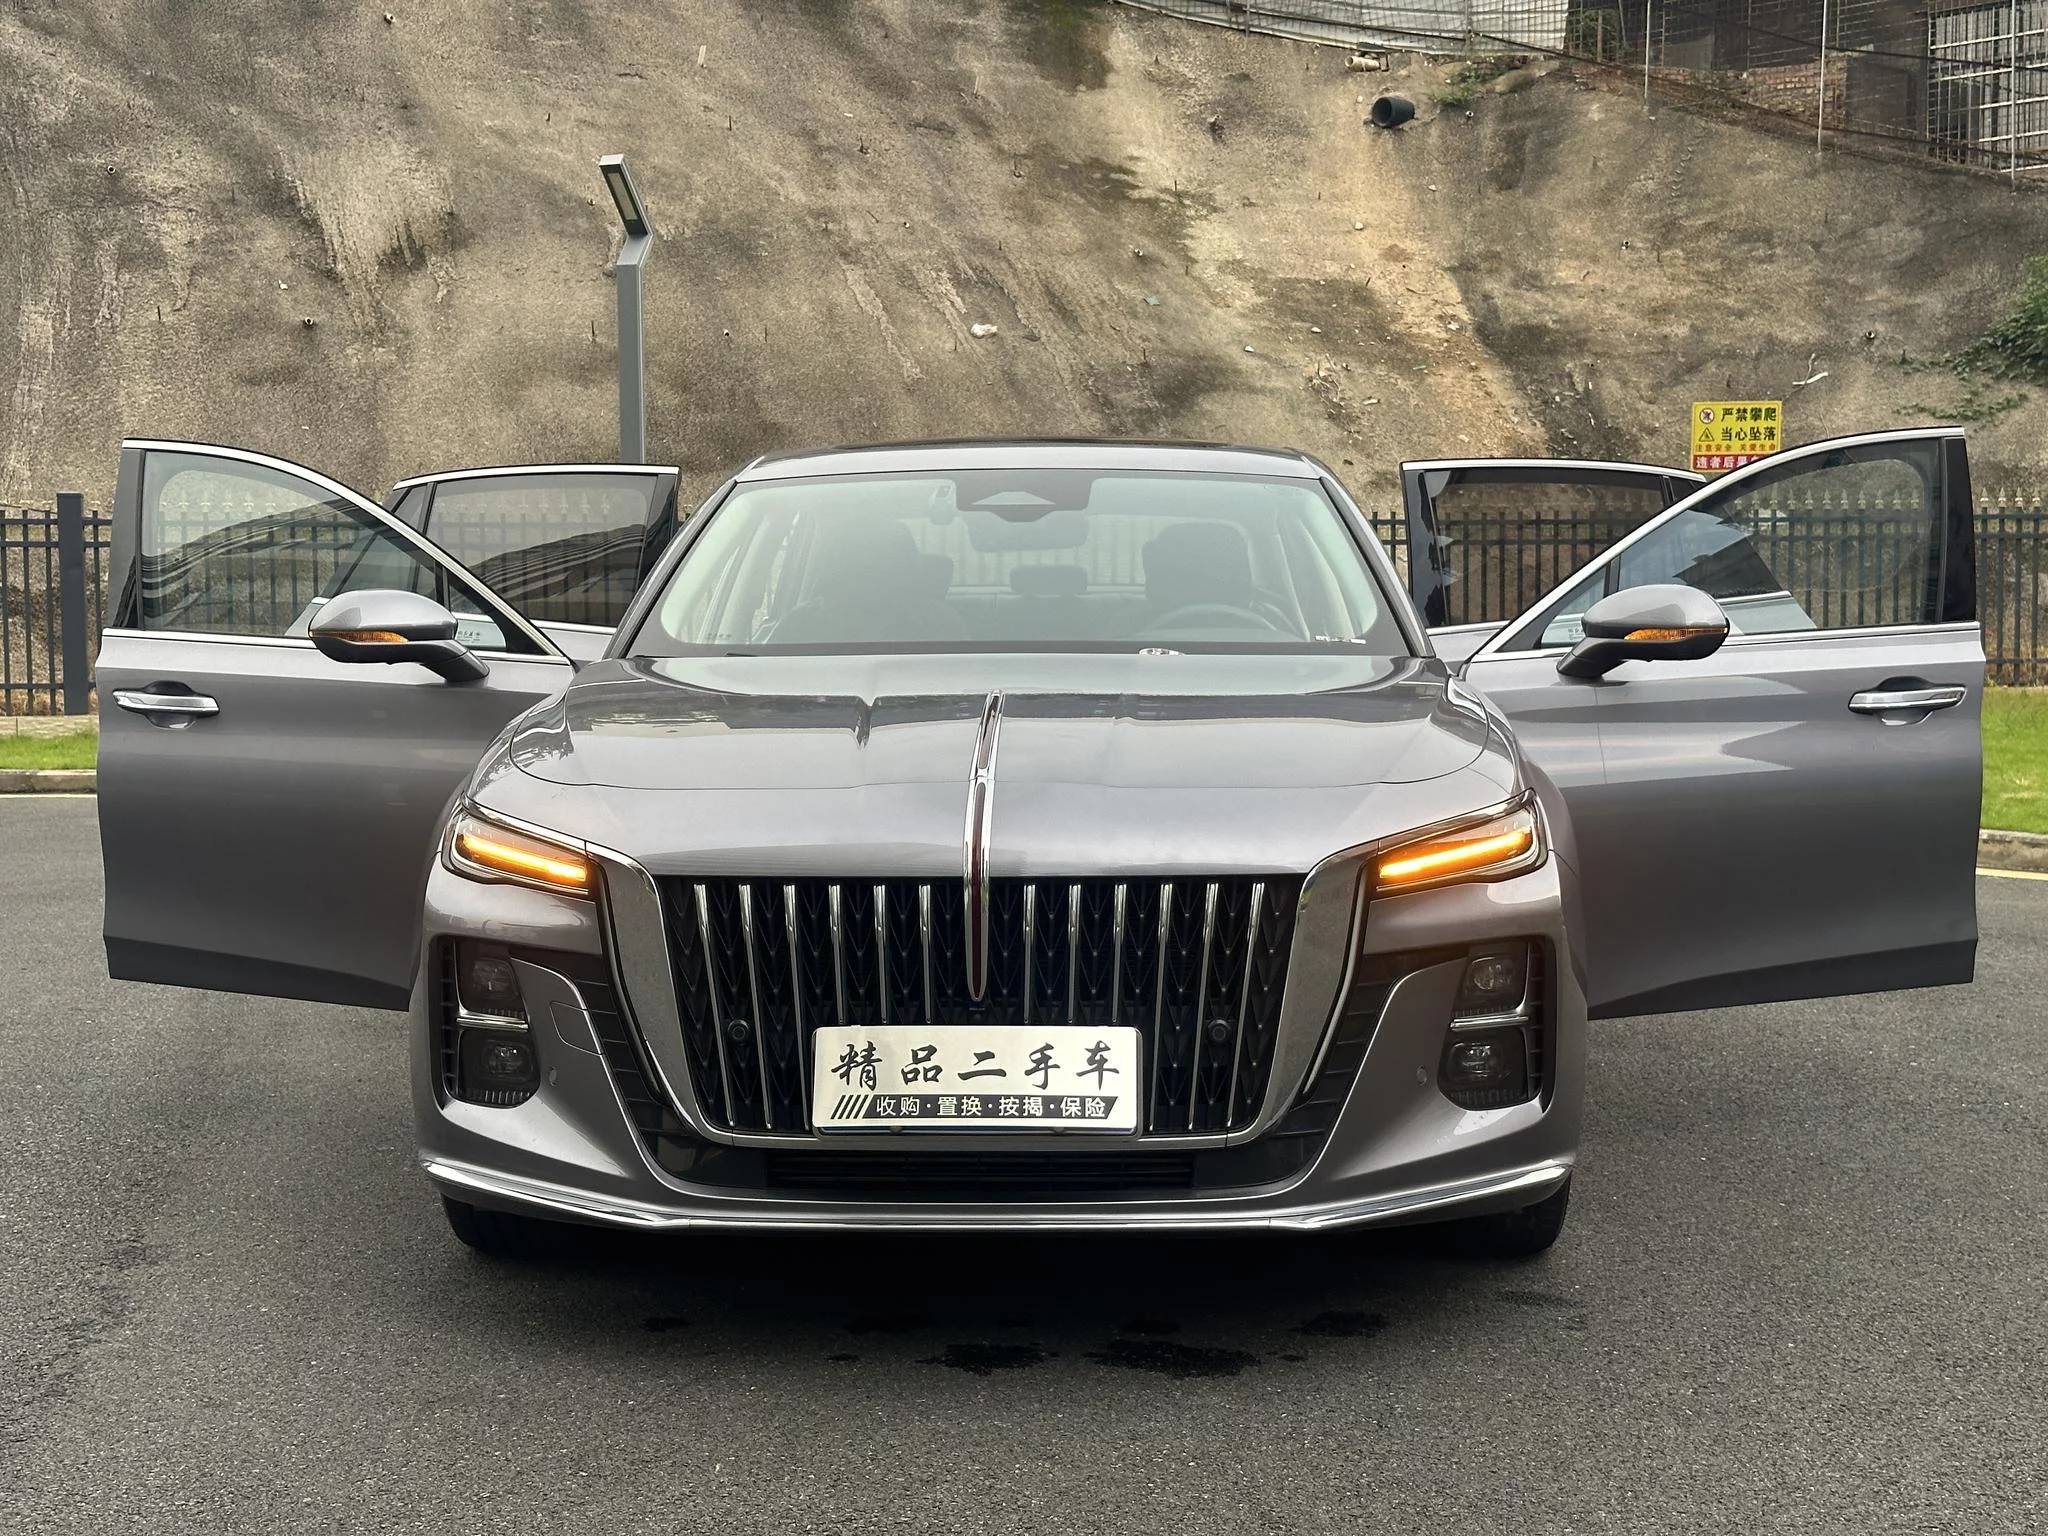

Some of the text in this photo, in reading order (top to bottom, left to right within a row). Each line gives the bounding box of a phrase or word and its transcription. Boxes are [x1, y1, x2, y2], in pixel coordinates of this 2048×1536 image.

[1721, 407, 1777, 422] 严禁攀爬
[1721, 427, 1776, 441] 当心坠落
[831, 1040, 1120, 1092] 精品二手车
